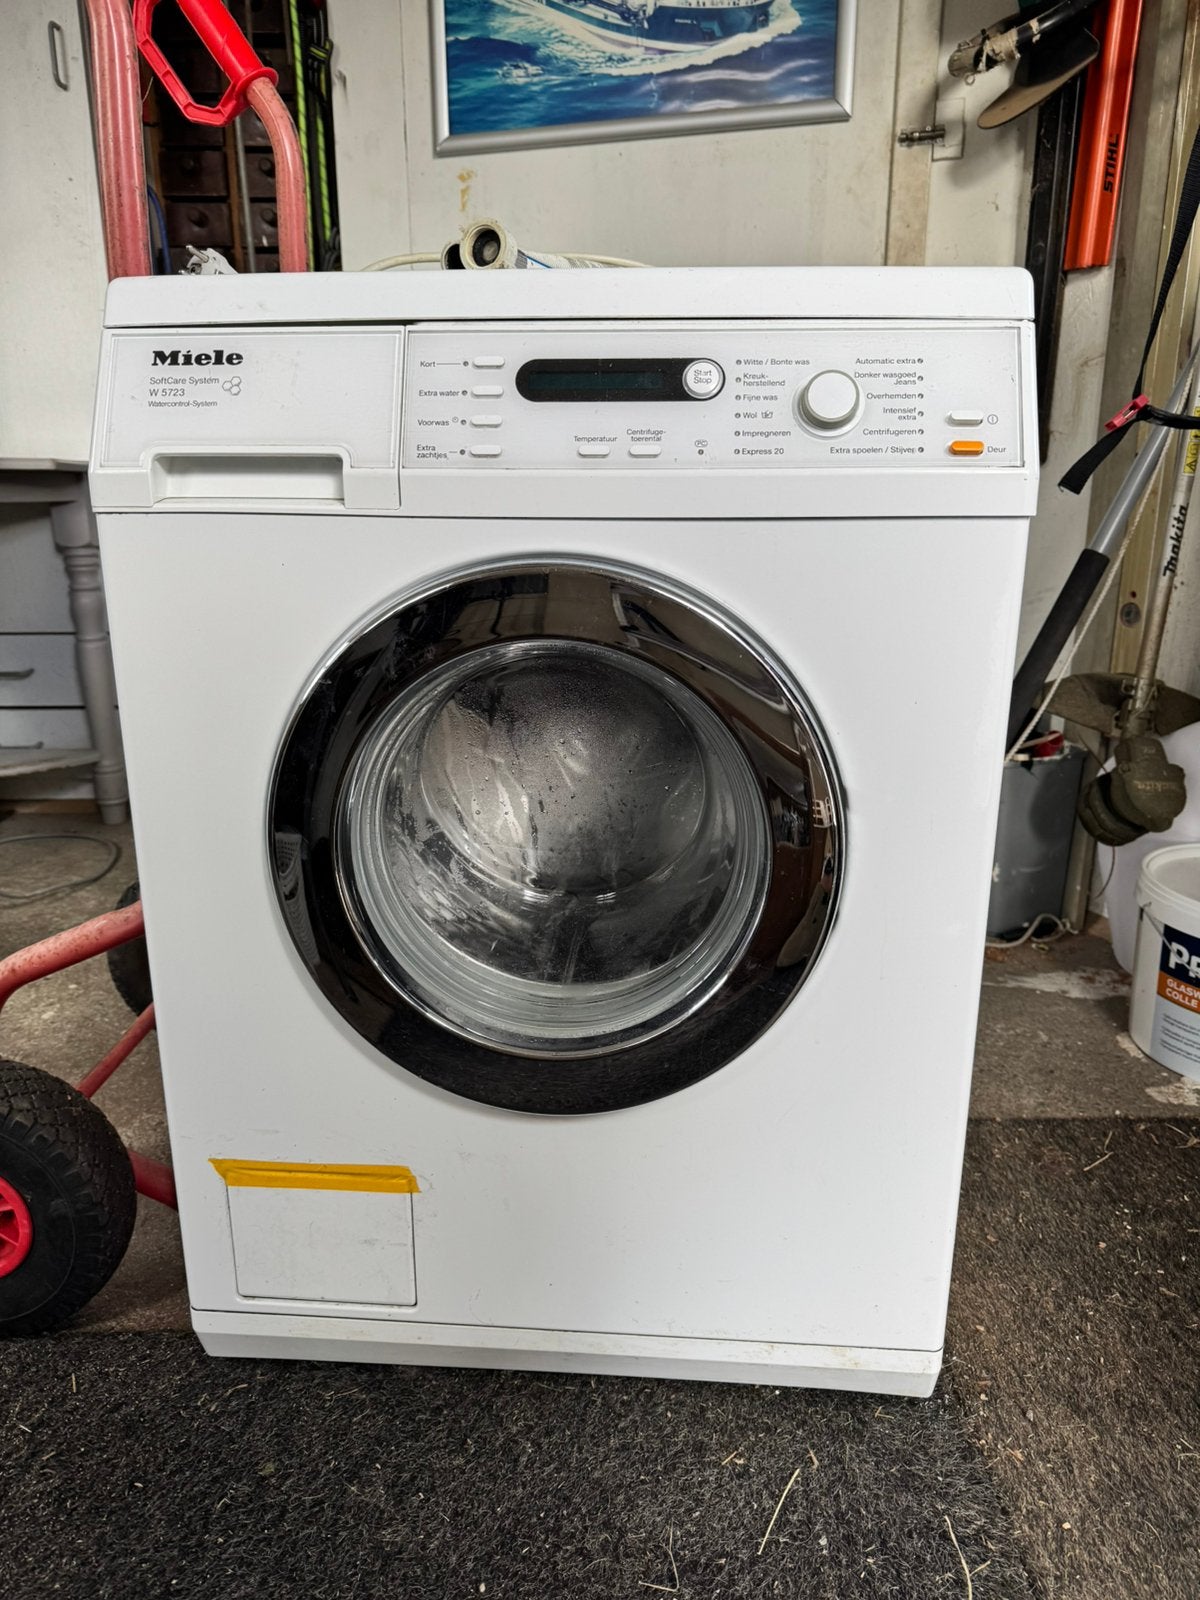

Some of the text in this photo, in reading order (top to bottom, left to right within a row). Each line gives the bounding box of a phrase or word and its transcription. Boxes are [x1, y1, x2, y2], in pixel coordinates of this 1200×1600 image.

[1104, 134, 1119, 193] STIHL
[152, 350, 244, 366] Miele
[694, 376, 712, 384] Stop
[882, 372, 916, 380] wasgoed
[150, 376, 220, 386] SoftCare System
[161, 388, 186, 396] 5723
[148, 400, 218, 408] Watercontrol-System
[742, 430, 792, 438] Impregneren
[862, 428, 917, 436] Centrifugeren
[416, 451, 448, 460] zachtjes
[742, 448, 772, 456] Express
[852, 447, 884, 456] spoelen
[1166, 988, 1199, 1008] COLLE
